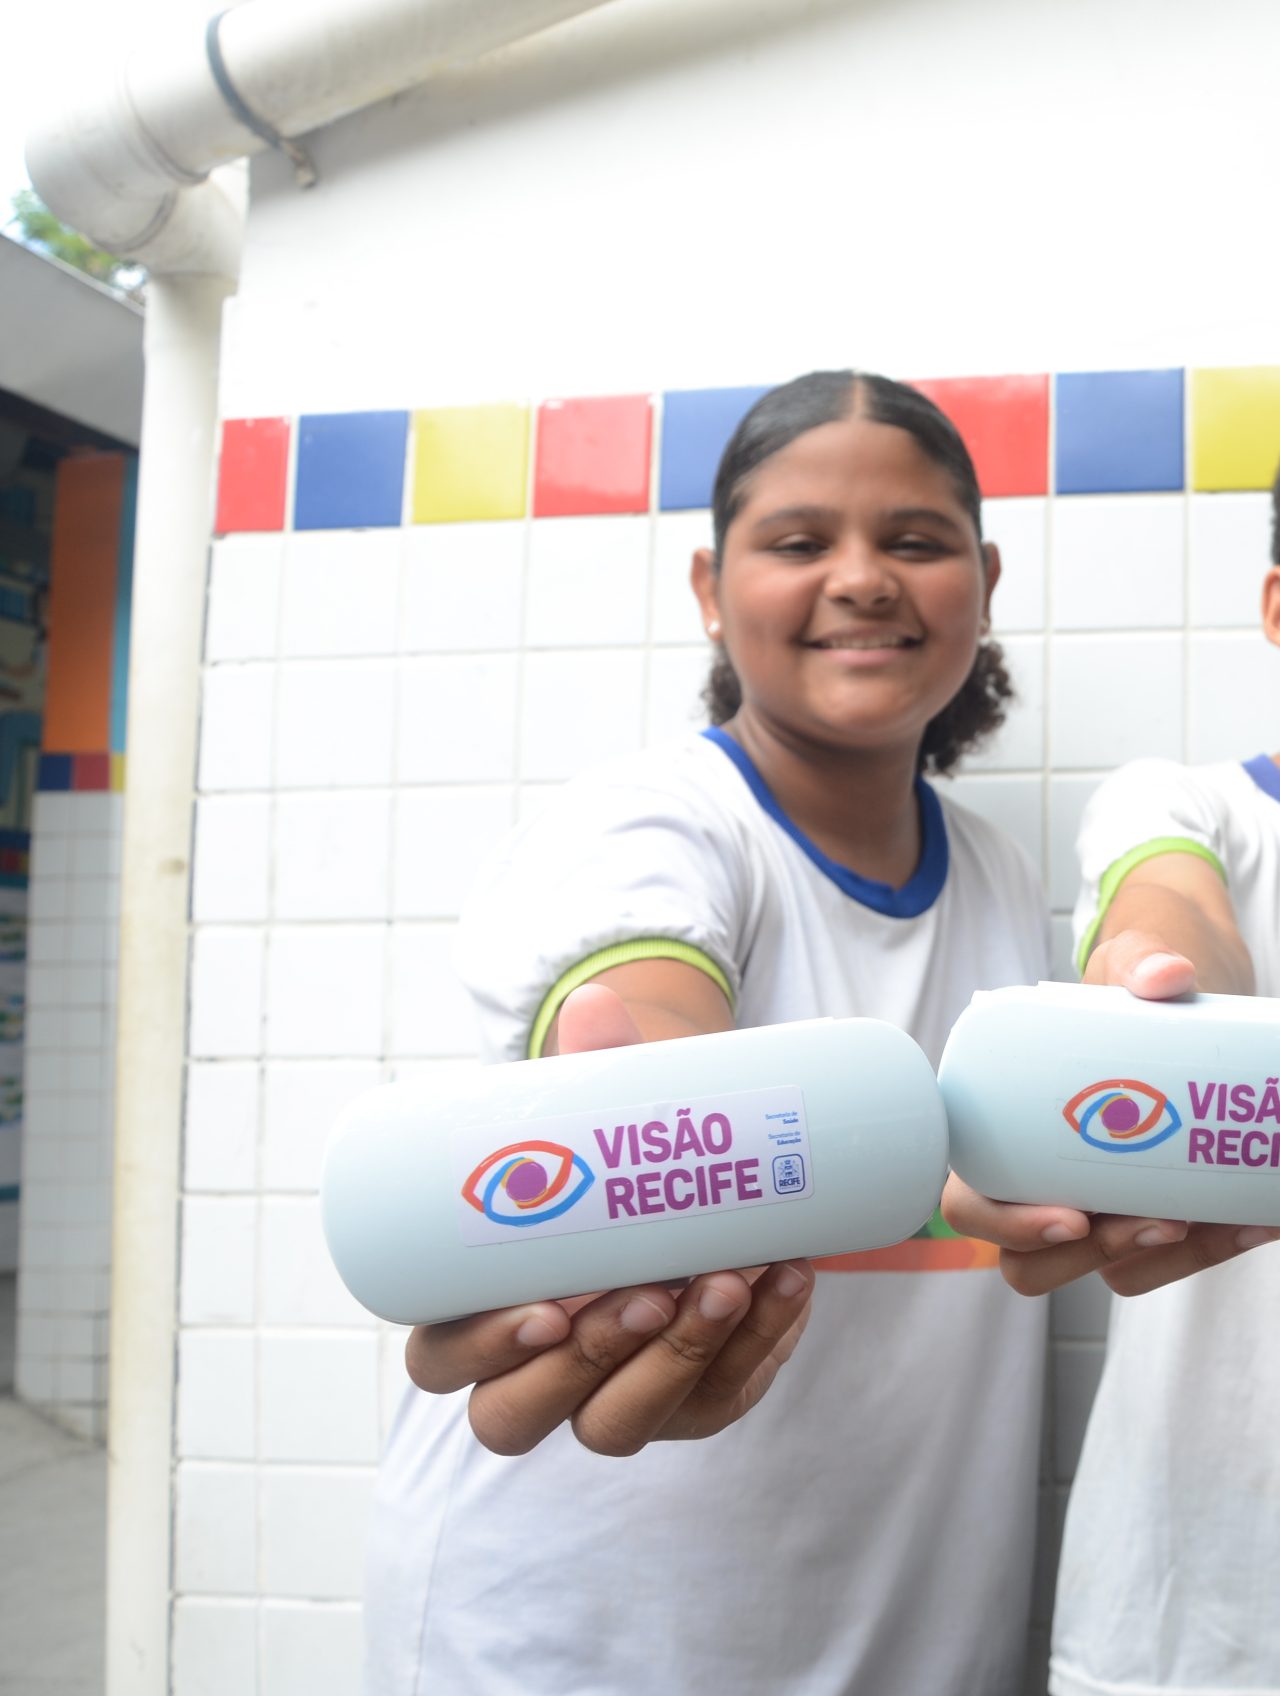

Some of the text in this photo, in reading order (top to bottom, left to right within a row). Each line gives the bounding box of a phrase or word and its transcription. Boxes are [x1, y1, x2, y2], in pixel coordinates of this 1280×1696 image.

[593, 1107, 734, 1170] VISÃO
[605, 1158, 763, 1220] RECIFE
[779, 1177, 801, 1187] RECIFE
